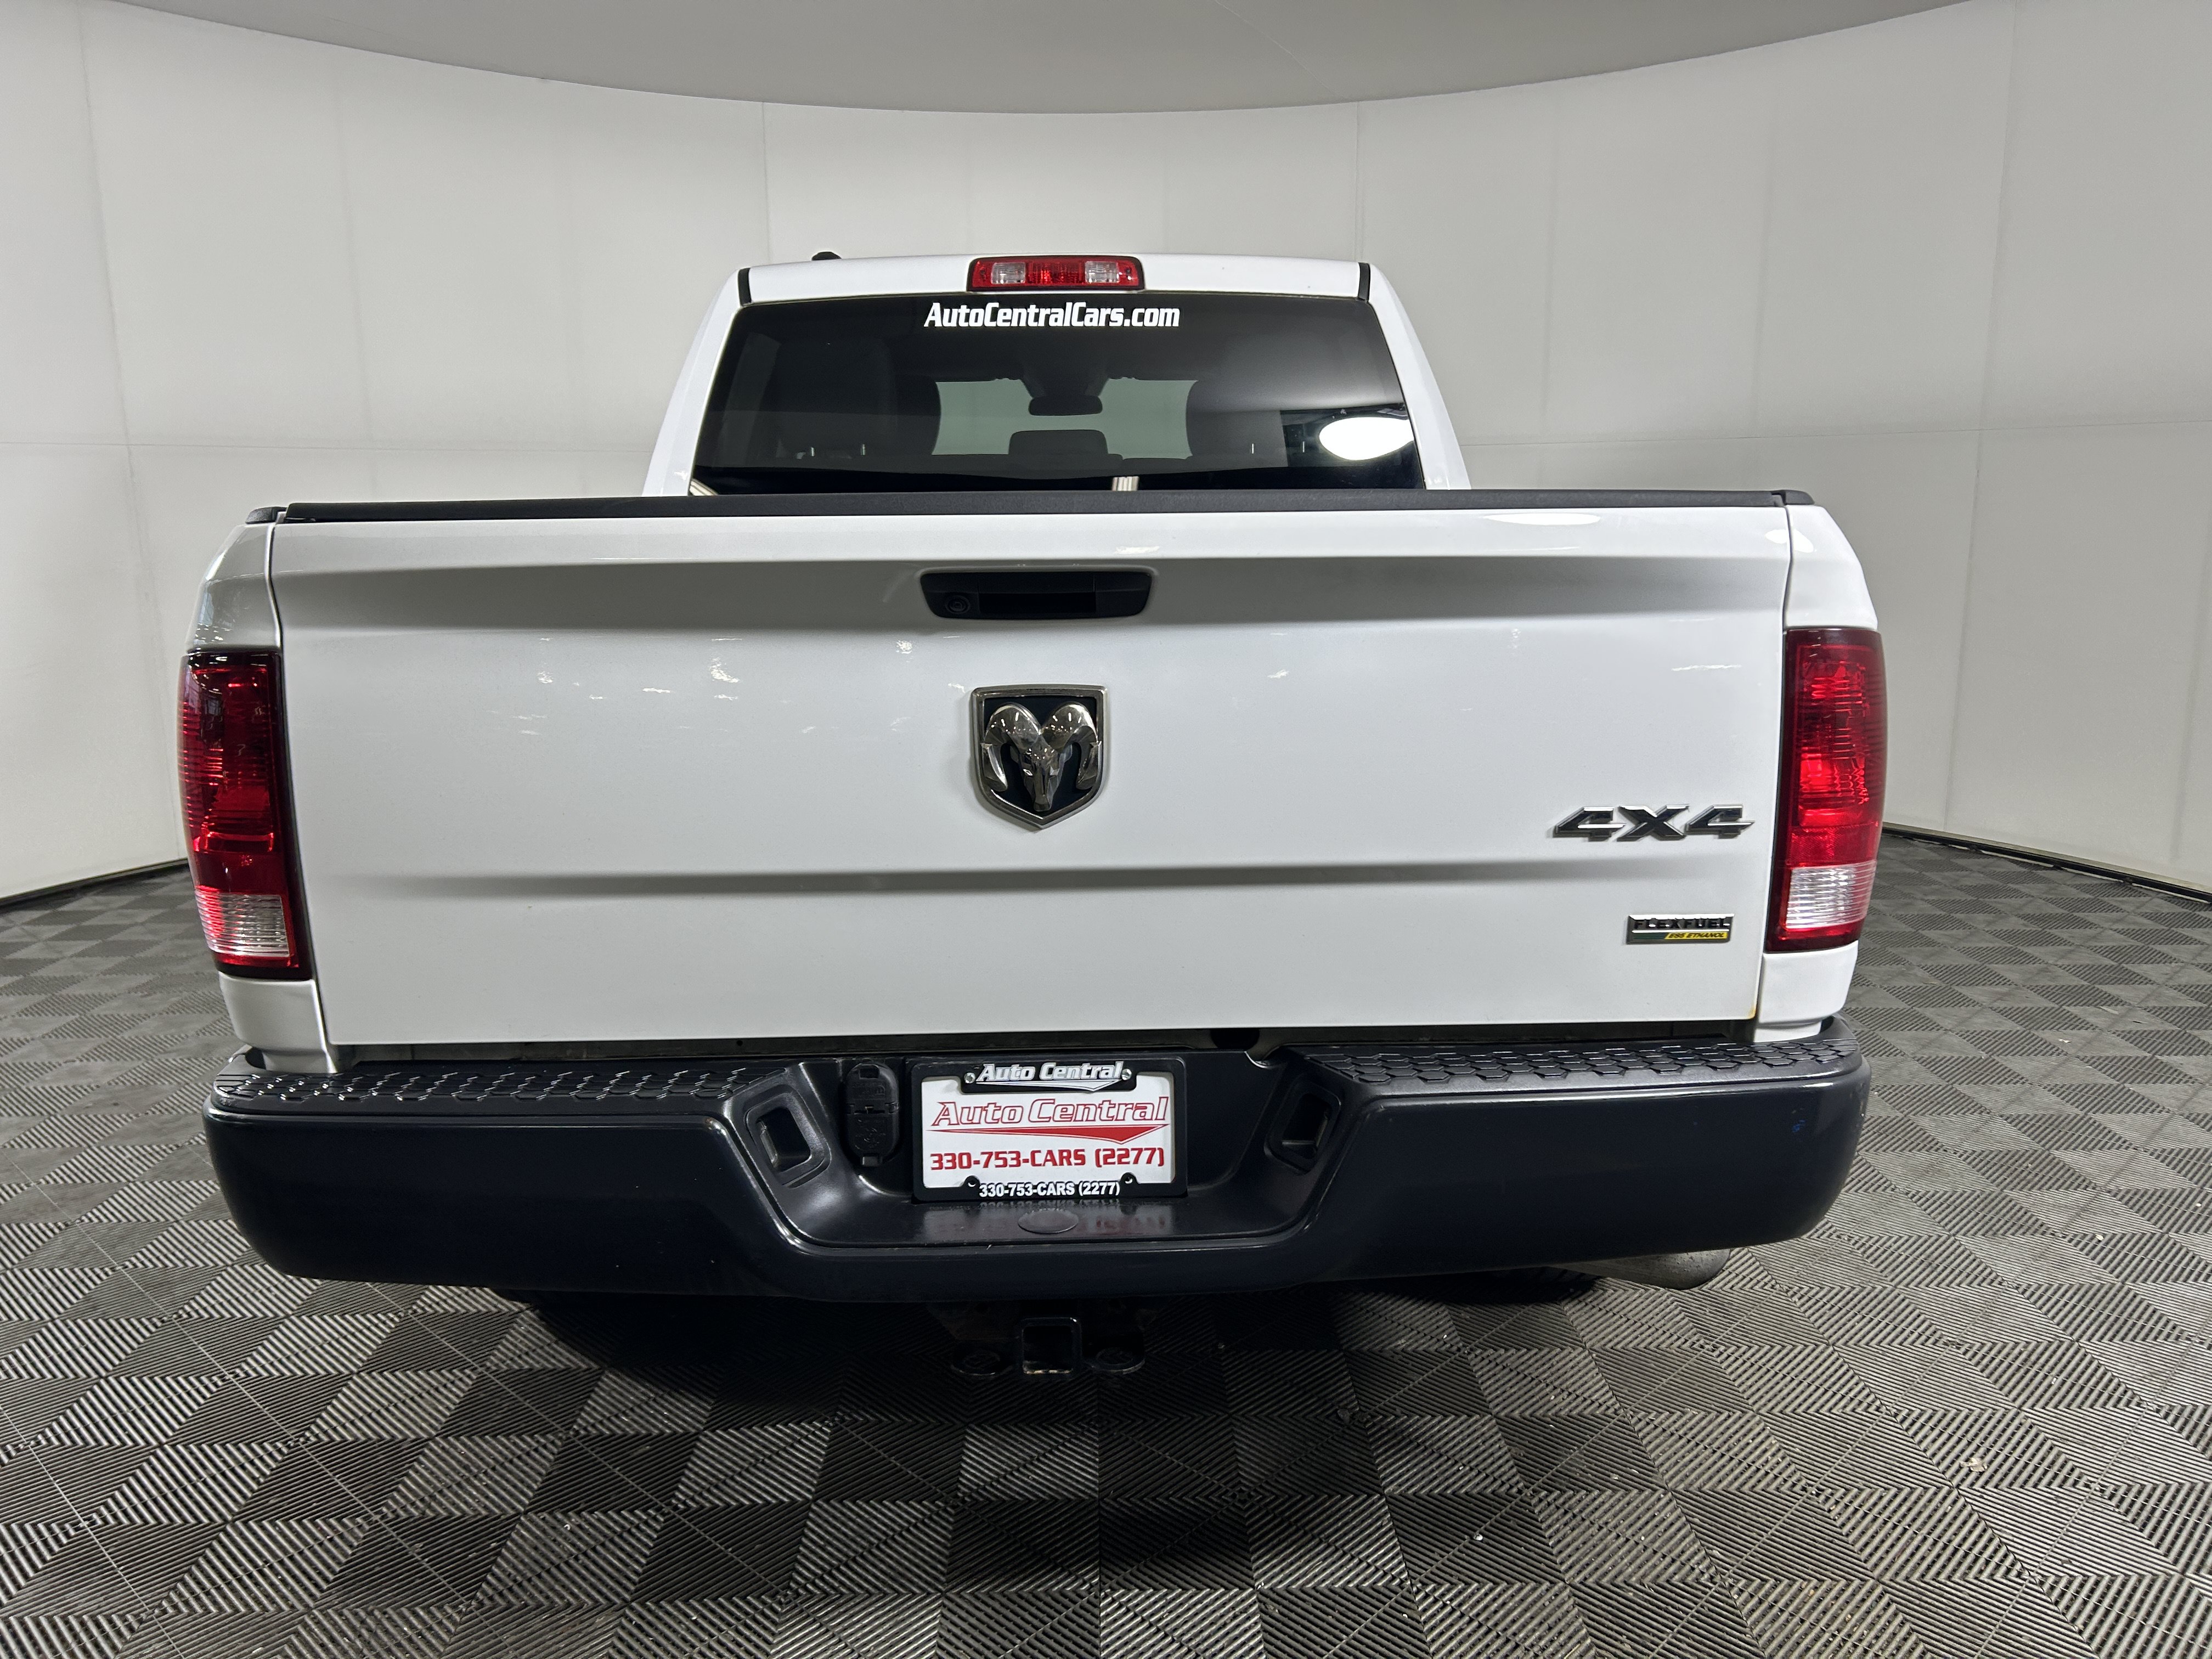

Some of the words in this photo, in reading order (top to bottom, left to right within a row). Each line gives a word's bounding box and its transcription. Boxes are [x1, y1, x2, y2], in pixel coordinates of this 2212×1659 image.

[924, 302, 1180, 328] AutoCentralCars.com
[976, 1063, 1036, 1082] Auto
[1040, 1061, 1124, 1080] Central
[931, 1101, 1024, 1126] Auto
[1028, 1096, 1169, 1123] Central
[930, 1148, 1086, 1170] 330-753-CARS
[1096, 1147, 1165, 1168] (2277)
[979, 1183, 1075, 1198] 330-753-CARS
[1079, 1181, 1120, 1197] (2277)
